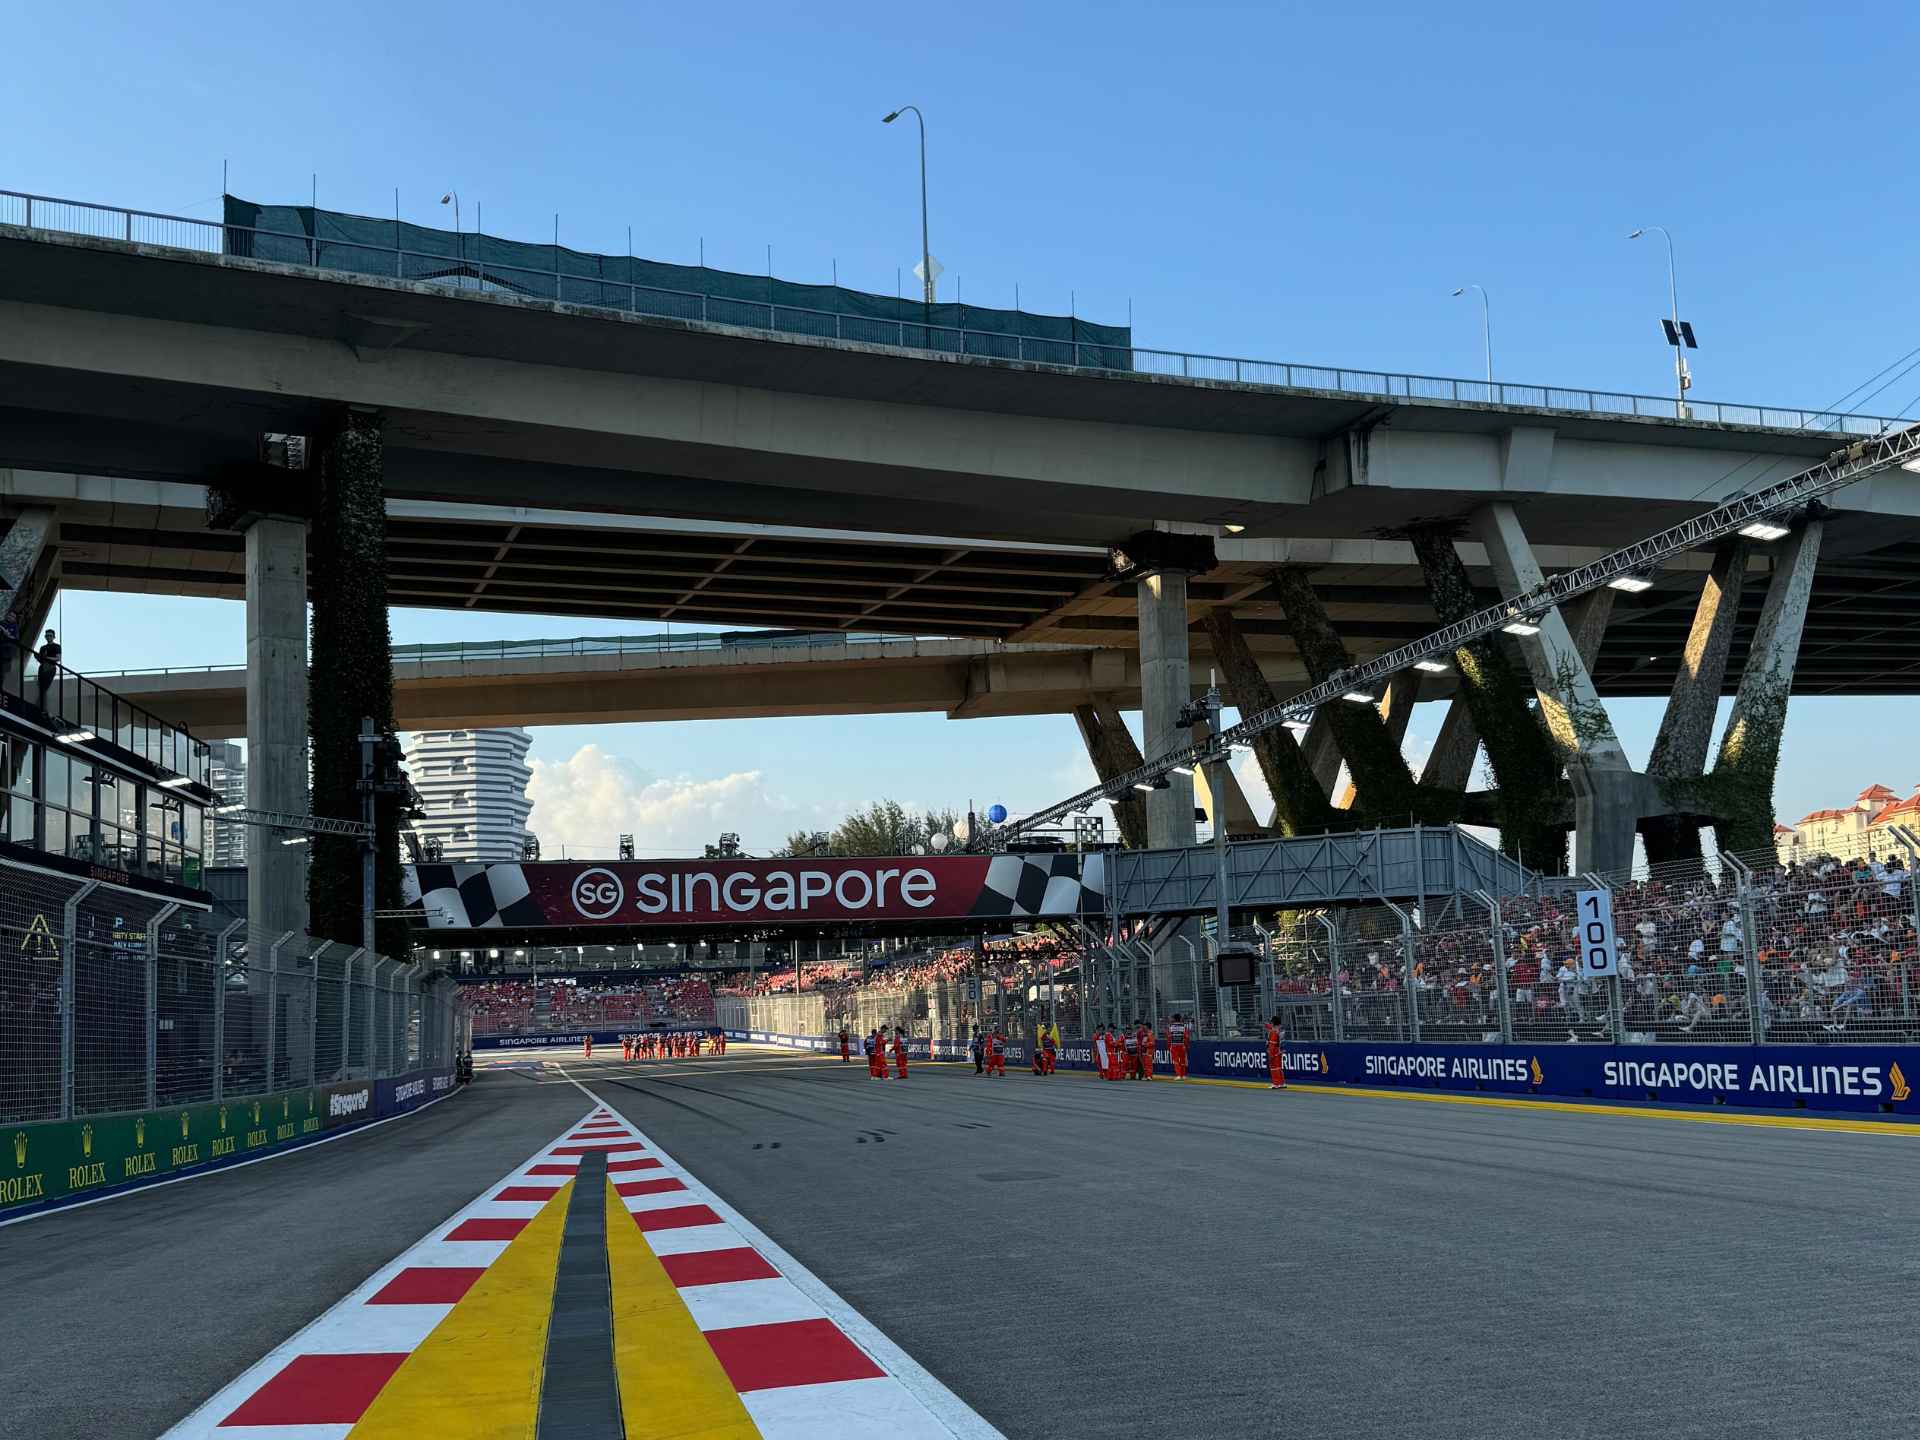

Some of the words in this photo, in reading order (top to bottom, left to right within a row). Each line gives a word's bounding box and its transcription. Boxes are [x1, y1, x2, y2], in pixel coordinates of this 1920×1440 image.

[578, 883, 618, 904] SG
[1584, 896, 1608, 970] 100
[499, 1037, 548, 1046] SINGAPORE
[1214, 1051, 1267, 1069] SINGAPORE
[1281, 1053, 1319, 1071] RLINES
[1365, 1055, 1446, 1077] SINGAPORE
[1451, 1058, 1528, 1081] AIRLINES
[1604, 1061, 1740, 1091] SINGAPORE
[1749, 1065, 1882, 1096] AIRLINES
[212, 1136, 235, 1157] ROLEX
[247, 1129, 268, 1148] ROLEX
[125, 1152, 156, 1177] ROLEX
[172, 1143, 199, 1166] ROLEX
[68, 1162, 106, 1189] ROLEX
